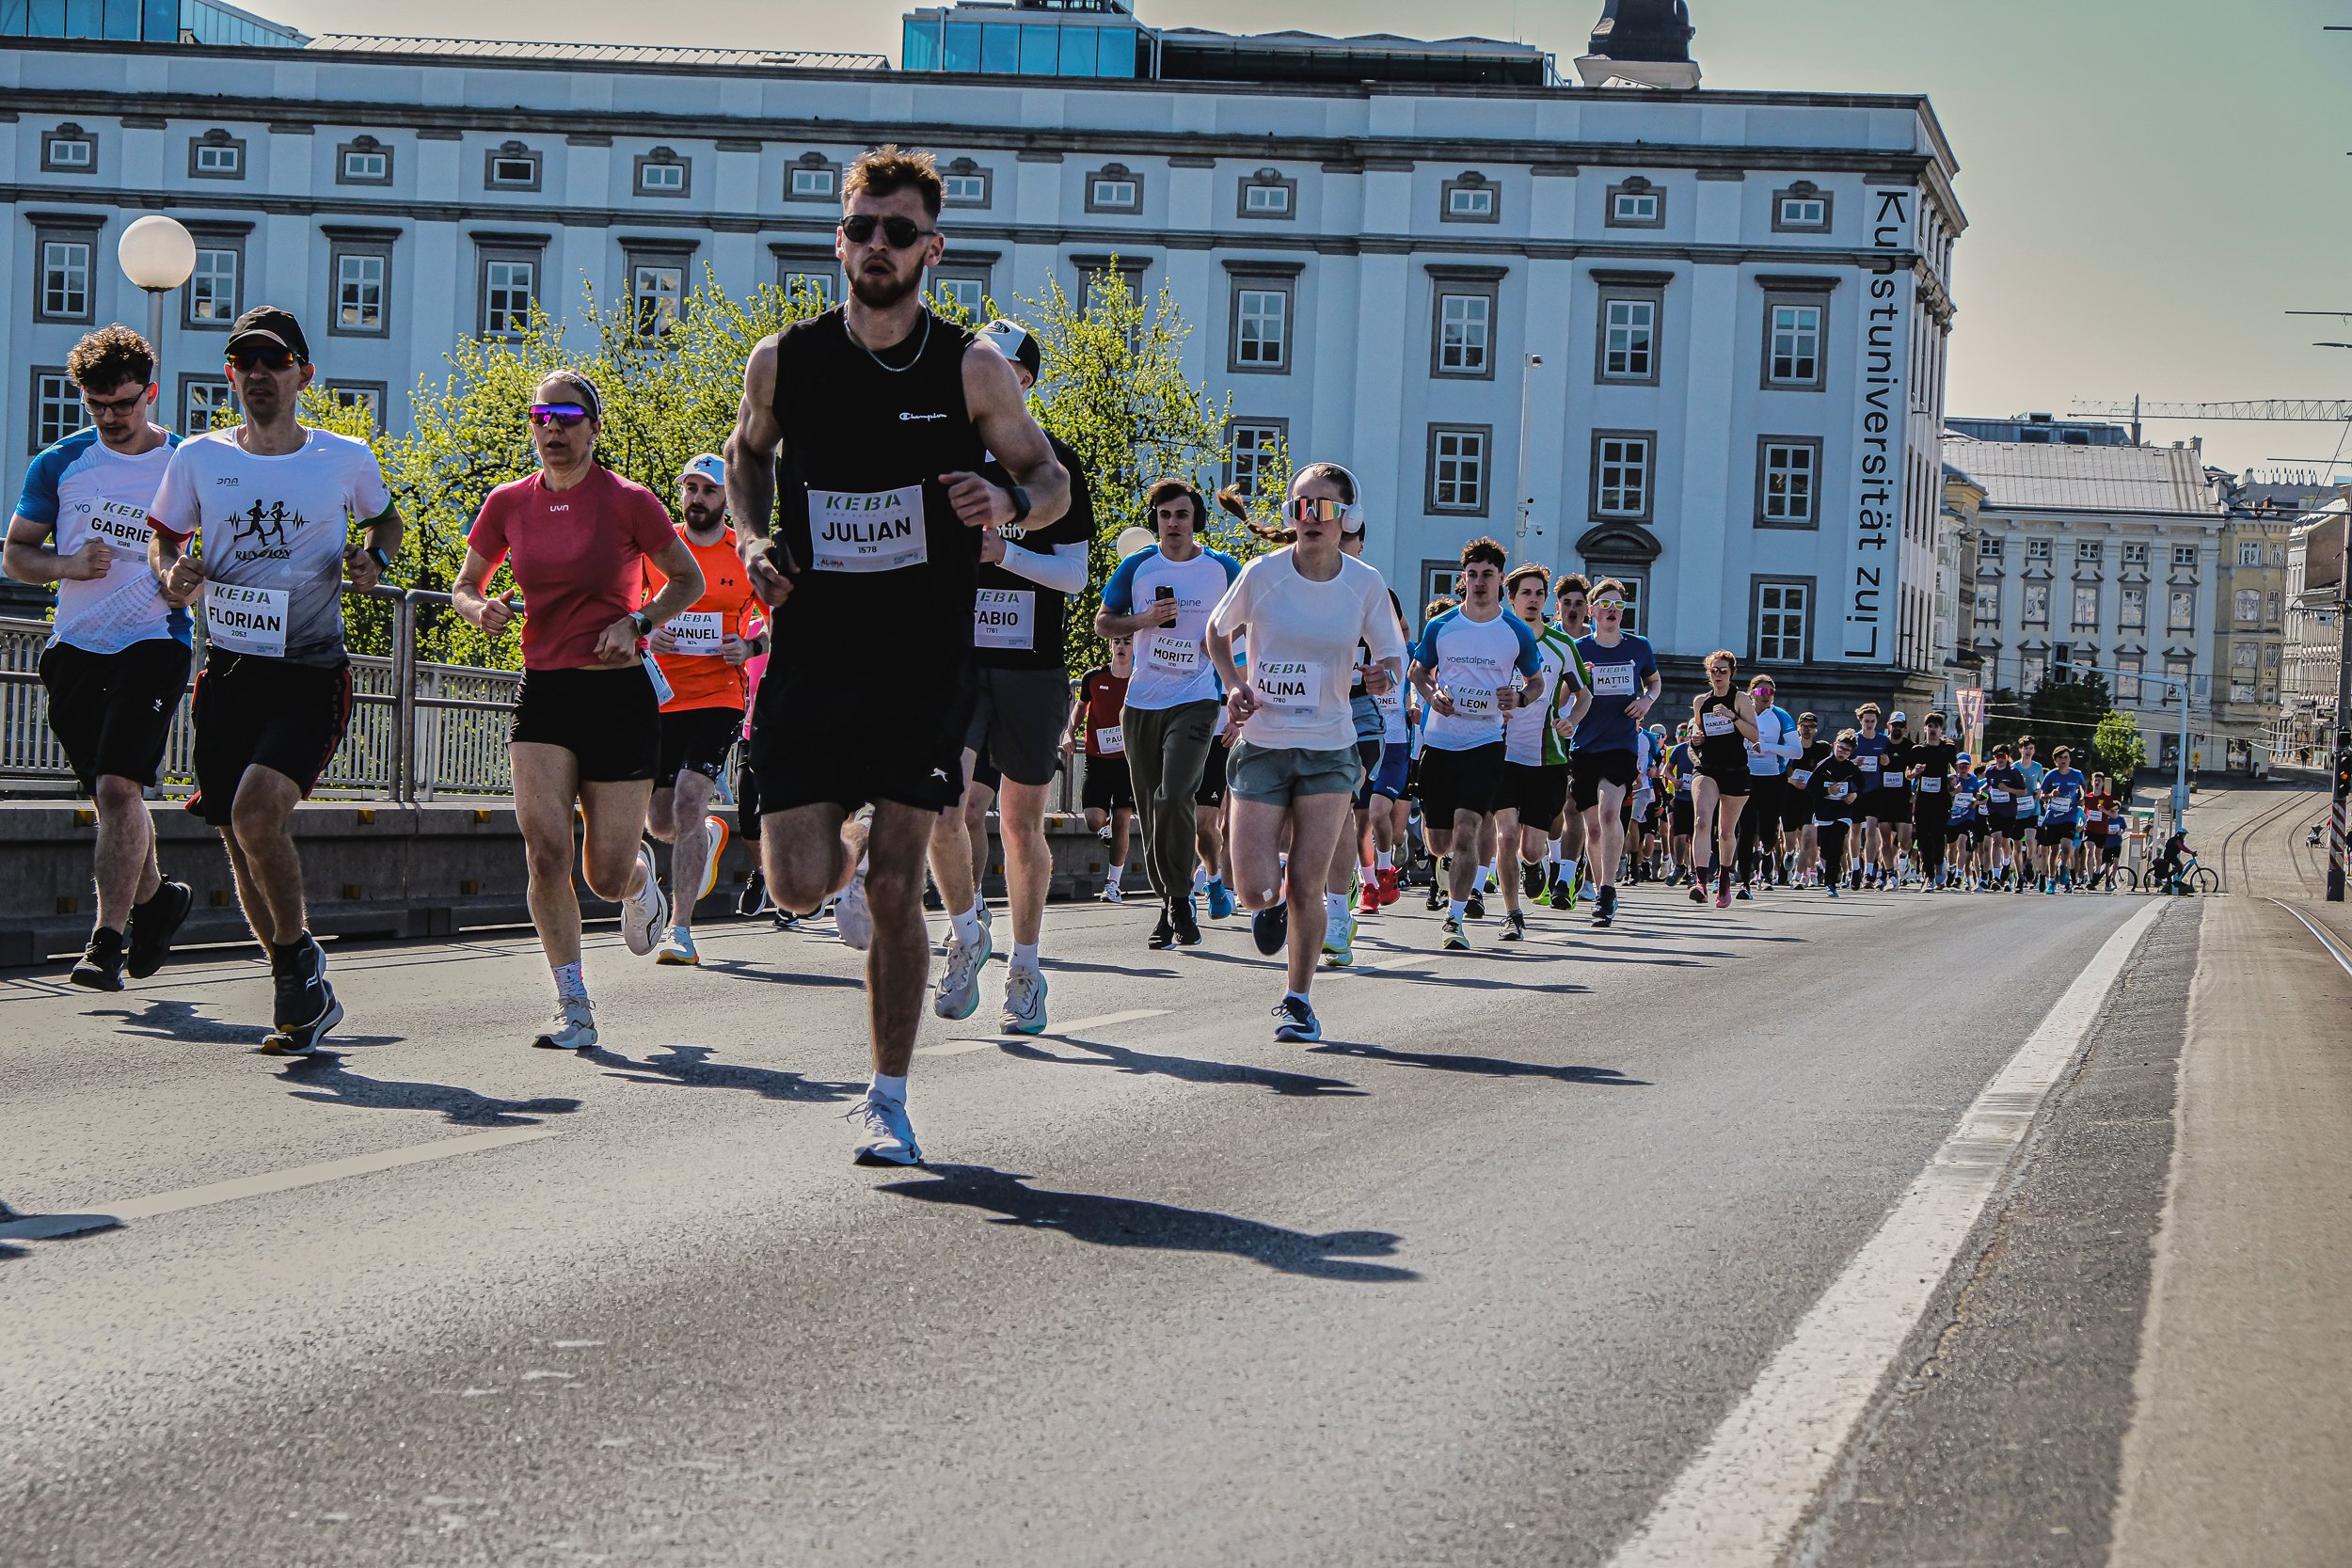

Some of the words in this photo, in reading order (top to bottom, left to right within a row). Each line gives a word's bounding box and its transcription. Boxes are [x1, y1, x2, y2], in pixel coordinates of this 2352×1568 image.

[1859, 191, 1908, 550] Kunstuniversität
[826, 494, 901, 511] KEBA
[103, 501, 150, 521] KEB
[91, 516, 152, 544] GABRIE
[821, 516, 912, 543] JULIAN
[857, 546, 877, 554] 1578
[215, 586, 271, 605] KEBA
[977, 591, 1020, 603] EBA
[209, 606, 280, 632] FLORIAN
[975, 610, 1018, 626] ABIO
[1844, 567, 1881, 657] Linz
[1157, 637, 1192, 648] KEBA
[1153, 648, 1194, 663] MORITZ
[1446, 655, 1496, 666] voestalpine
[1259, 661, 1307, 673] KEBA
[1258, 677, 1306, 696] ALINA
[1597, 675, 1630, 685] MATTIS
[1458, 686, 1491, 697] KEBA
[1459, 698, 1488, 709] LEON
[1105, 736, 1122, 744] PAU
